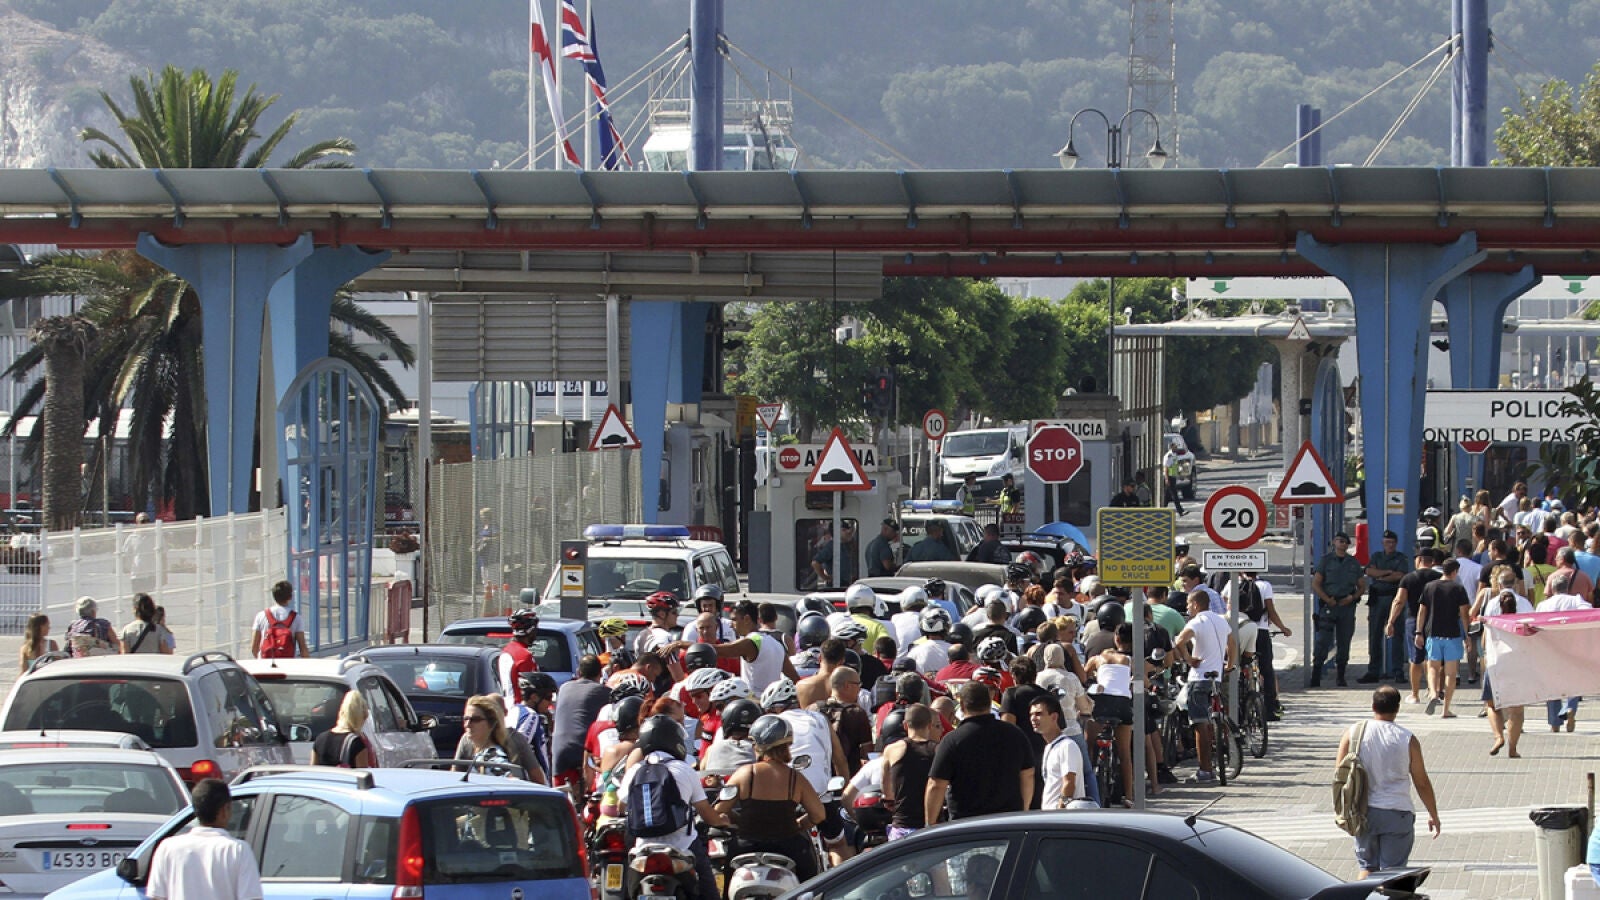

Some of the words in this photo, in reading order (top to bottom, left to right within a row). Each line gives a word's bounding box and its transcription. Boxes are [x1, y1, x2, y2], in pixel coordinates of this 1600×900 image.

[929, 419, 942, 431] 10
[1423, 427, 1499, 442] ONTROL
[1508, 428, 1532, 442] DE
[1033, 447, 1077, 461] STOP
[1220, 507, 1254, 529] 20
[53, 852, 97, 868] 4533
